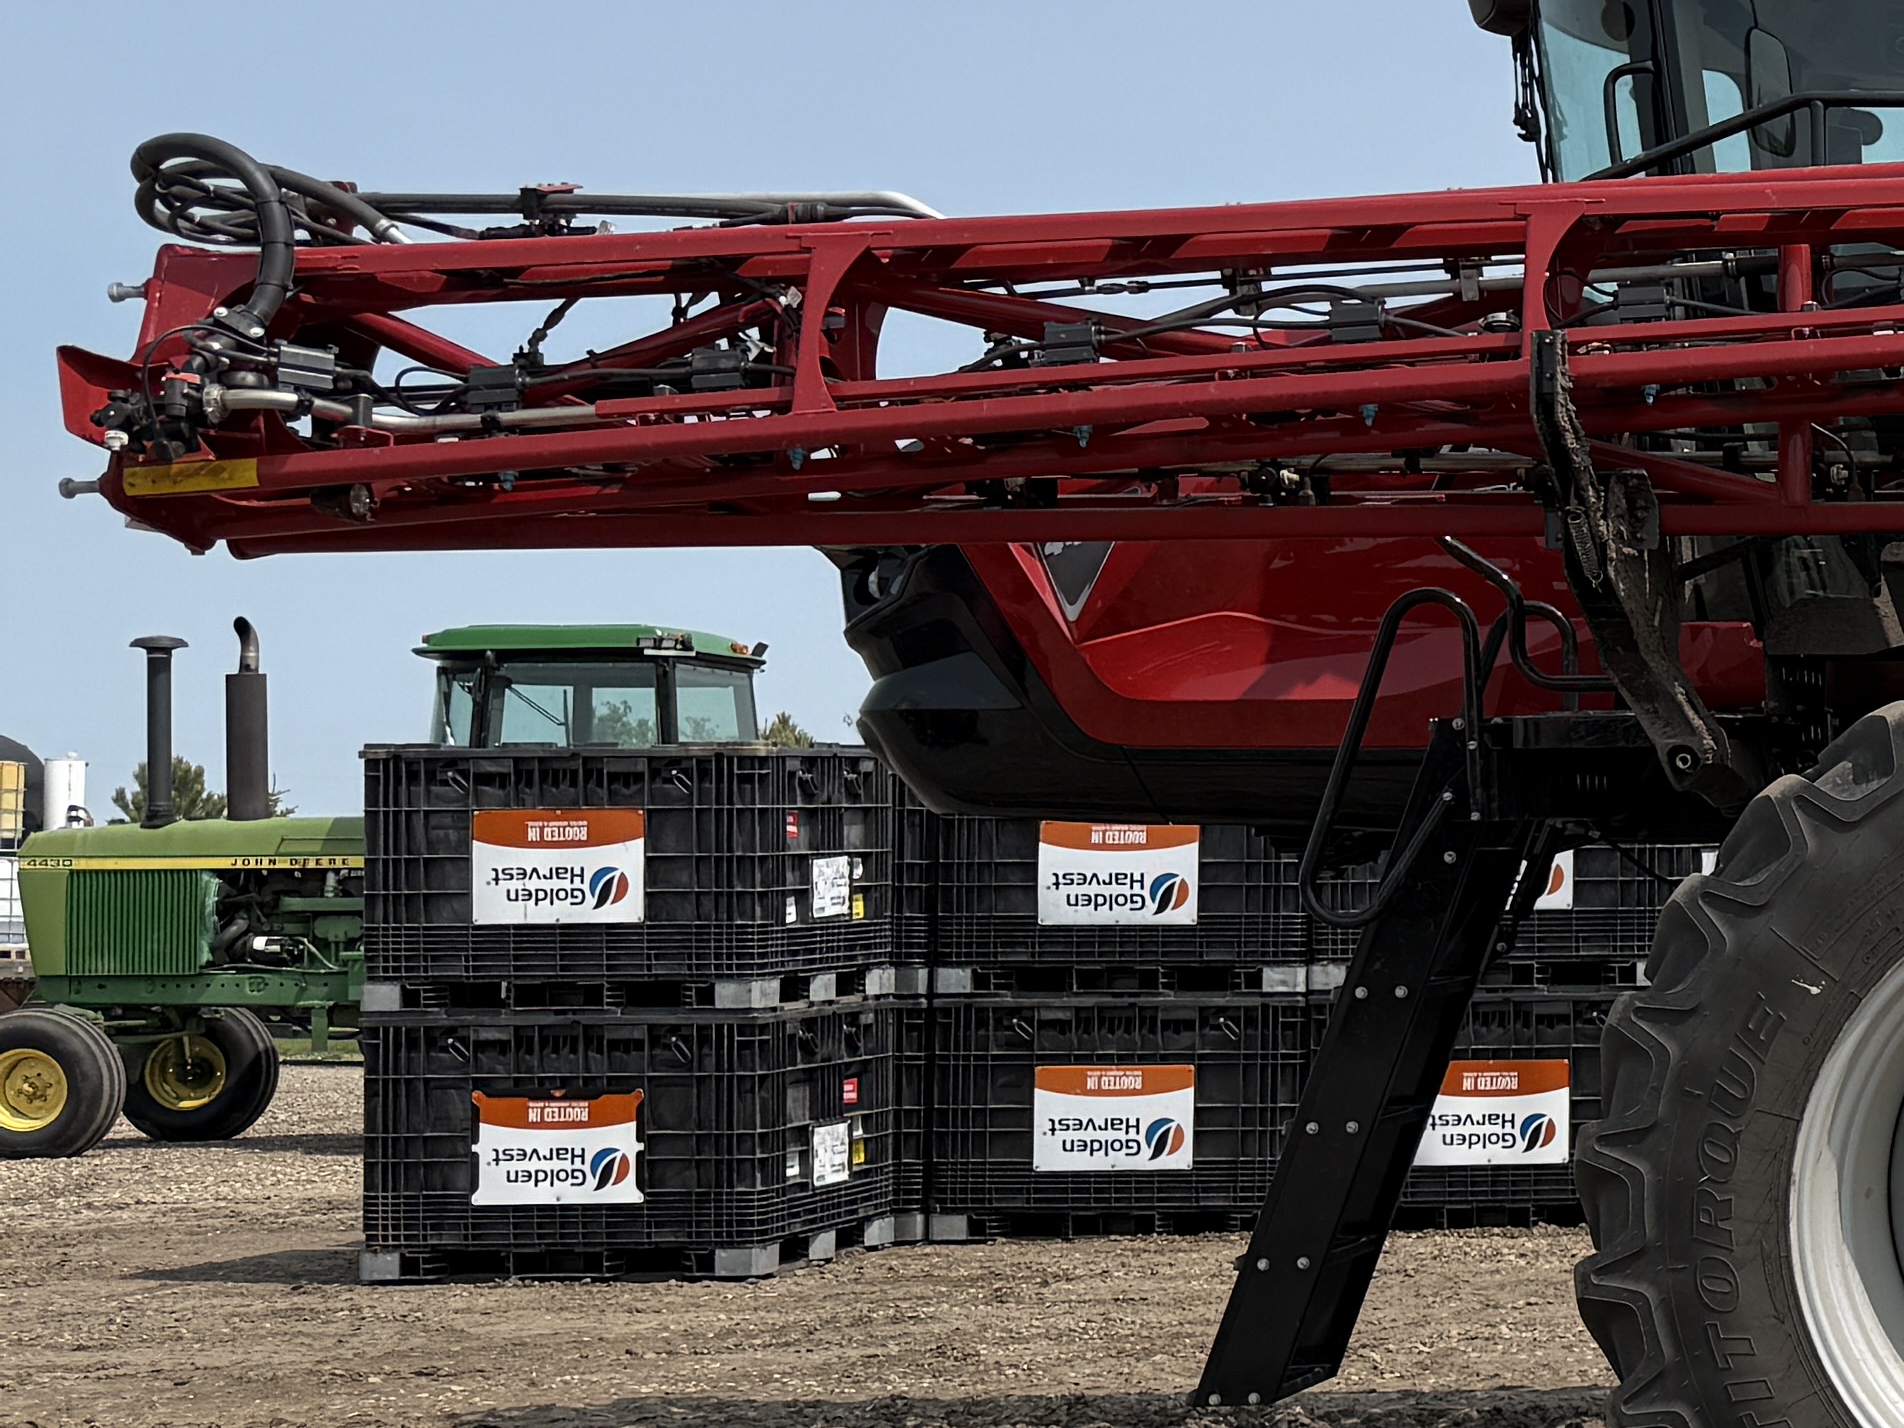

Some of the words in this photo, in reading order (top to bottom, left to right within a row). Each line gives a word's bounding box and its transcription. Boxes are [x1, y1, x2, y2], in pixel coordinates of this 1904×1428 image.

[527, 826, 540, 842] IN
[544, 826, 588, 841] ROOTED
[1090, 830, 1102, 844] IN
[1105, 830, 1147, 844] ROOTED
[26, 858, 73, 867] 4430
[231, 858, 277, 867] JOHN
[289, 858, 350, 867] DEERE
[491, 866, 585, 886] Harvest
[1052, 872, 1145, 890] Harvest
[506, 888, 586, 906] Golden
[1066, 893, 1146, 912] Golden
[1086, 1076, 1098, 1090] IN
[1101, 1076, 1142, 1090] ROOTED
[1462, 1076, 1475, 1091] IN
[1477, 1076, 1518, 1091] ROOTED
[528, 1107, 541, 1122] IN
[544, 1107, 589, 1122] ROOTED
[1429, 1113, 1516, 1131] Harvest
[1048, 1117, 1140, 1136] Harvest
[1062, 1139, 1141, 1157] Golden
[1442, 1132, 1517, 1149] Golden
[492, 1148, 585, 1166] Harvest
[506, 1169, 587, 1187] Golden
